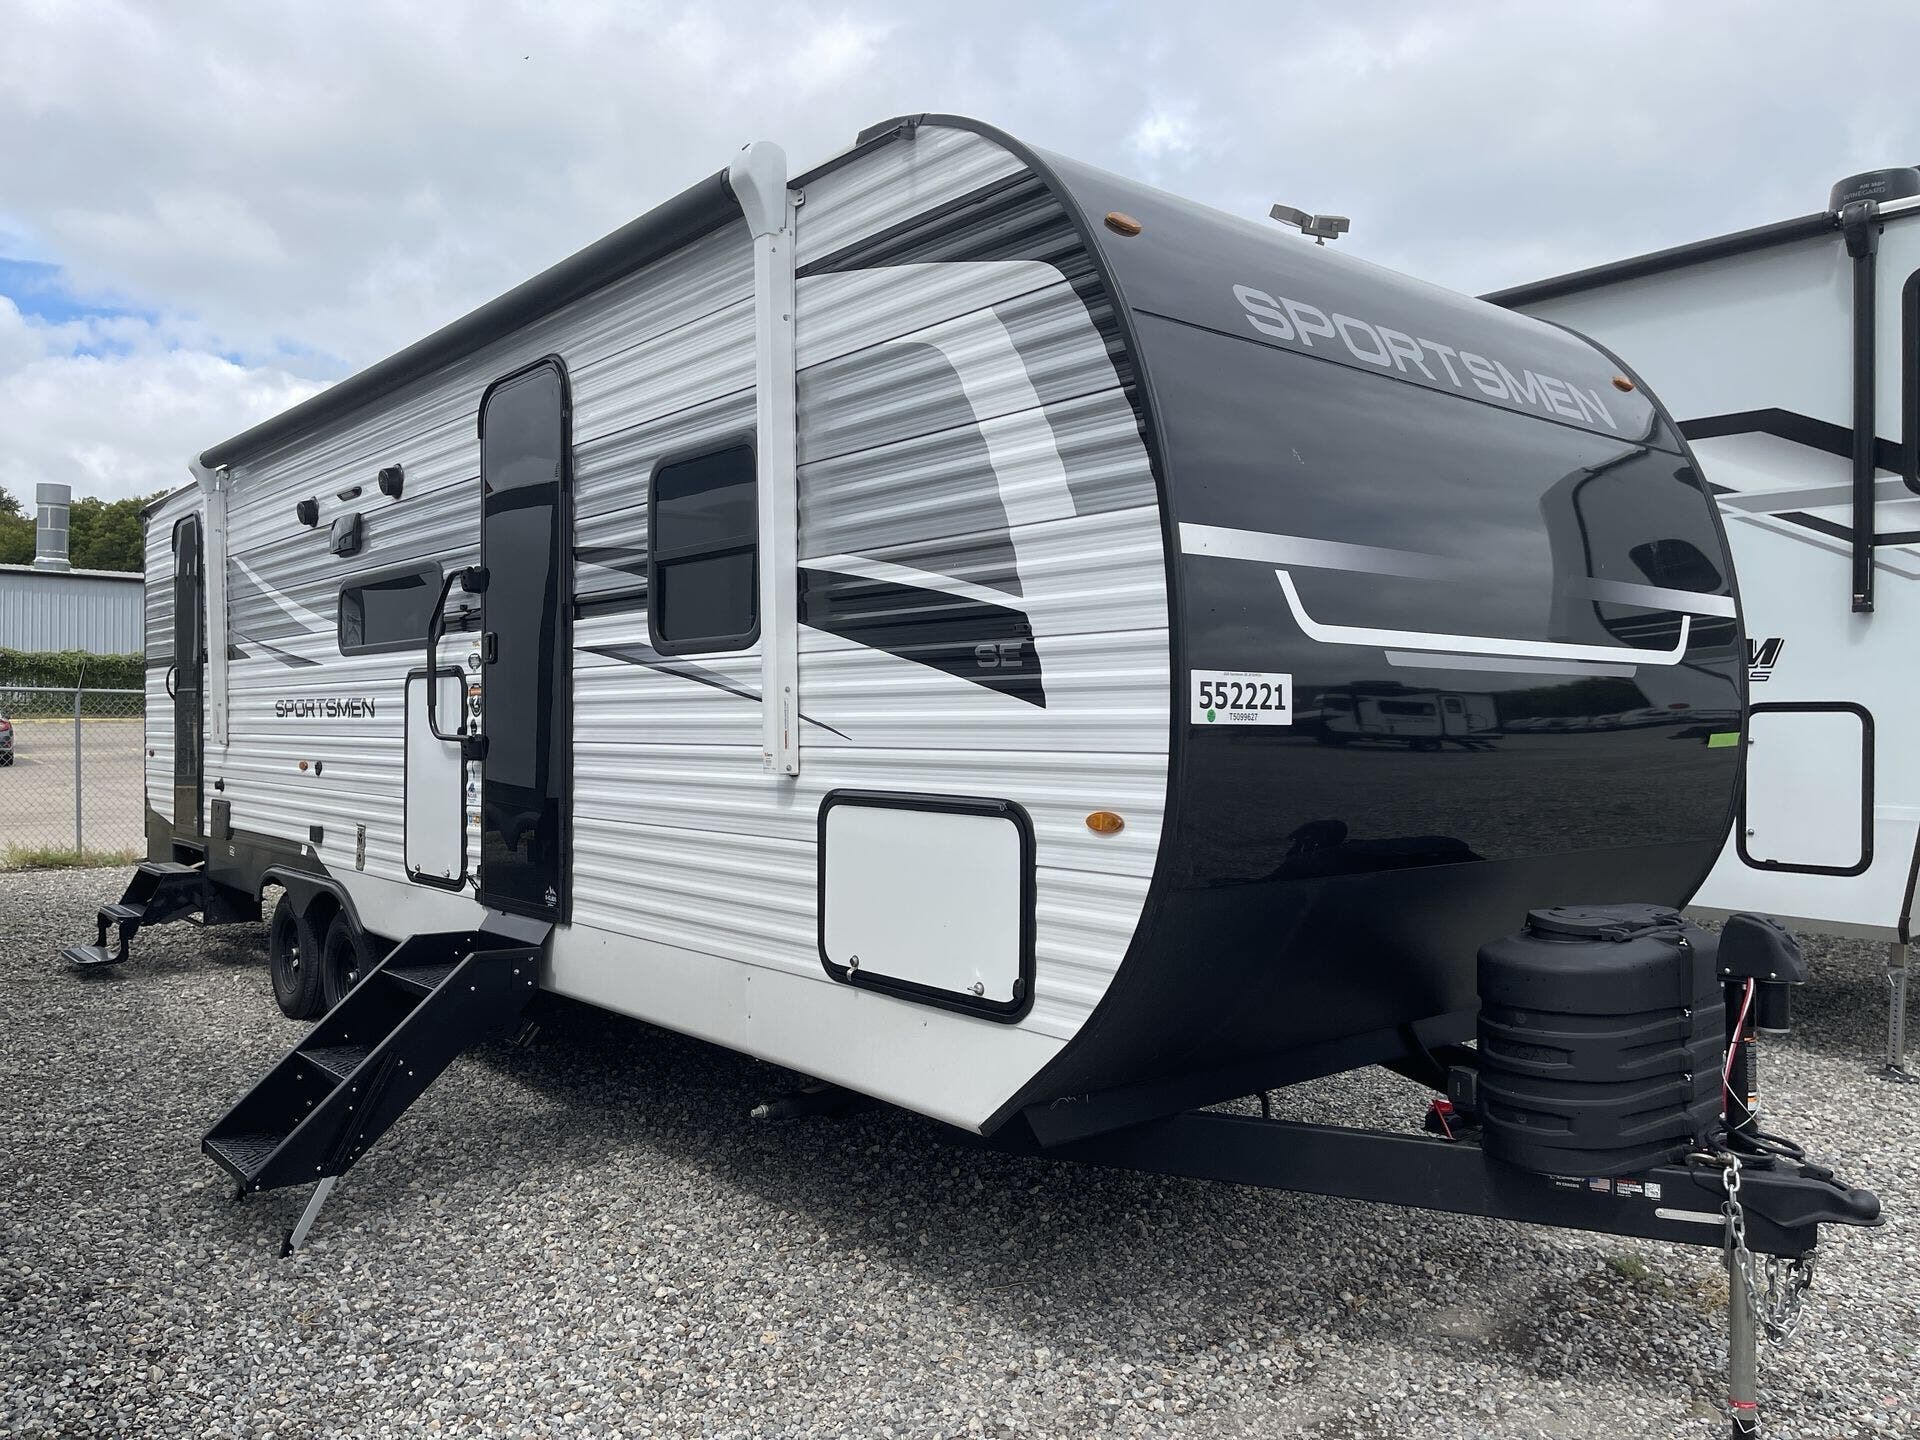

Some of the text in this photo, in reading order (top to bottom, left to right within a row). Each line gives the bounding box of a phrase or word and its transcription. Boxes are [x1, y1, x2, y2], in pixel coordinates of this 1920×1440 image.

[1232, 284, 1618, 430] SPORTSMEN
[974, 642, 1023, 668] SE
[275, 698, 375, 718] SPORTSMEN
[1199, 681, 1286, 710] 552221
[1229, 712, 1258, 721] T5099627
